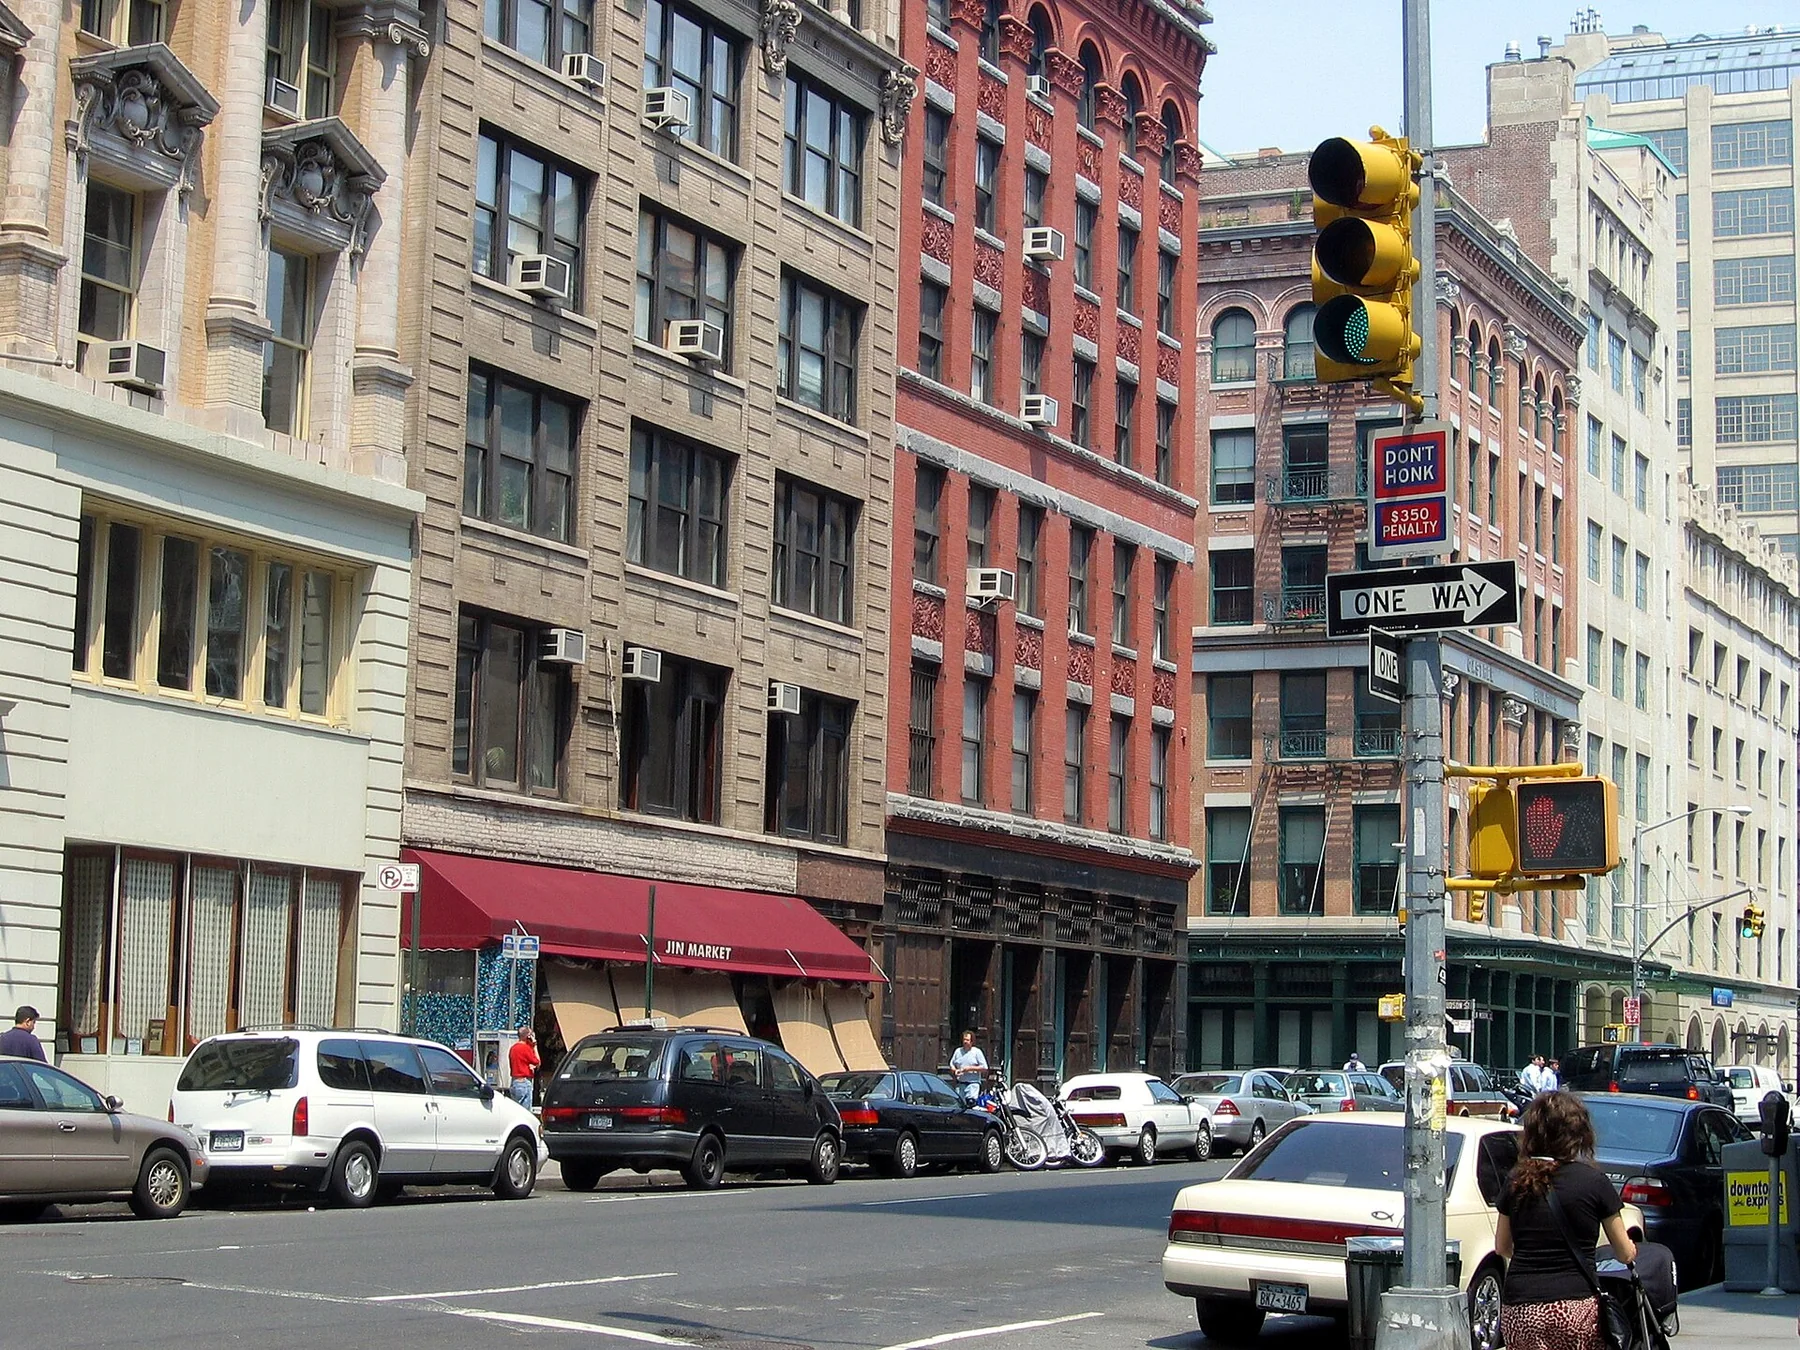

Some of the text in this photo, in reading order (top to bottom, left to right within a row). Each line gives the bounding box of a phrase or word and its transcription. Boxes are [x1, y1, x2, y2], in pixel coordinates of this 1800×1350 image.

[1385, 445, 1435, 465] DON'T
[1385, 464, 1435, 485] HONK
[1391, 507, 1429, 523] $350
[1383, 520, 1438, 538] PENALTY
[1354, 582, 1487, 616] ONE WAY
[1379, 650, 1398, 680] ONE
[665, 940, 732, 960] JIN MARKET
[1730, 1179, 1783, 1197] downton
[1746, 1195, 1785, 1210] exprs
